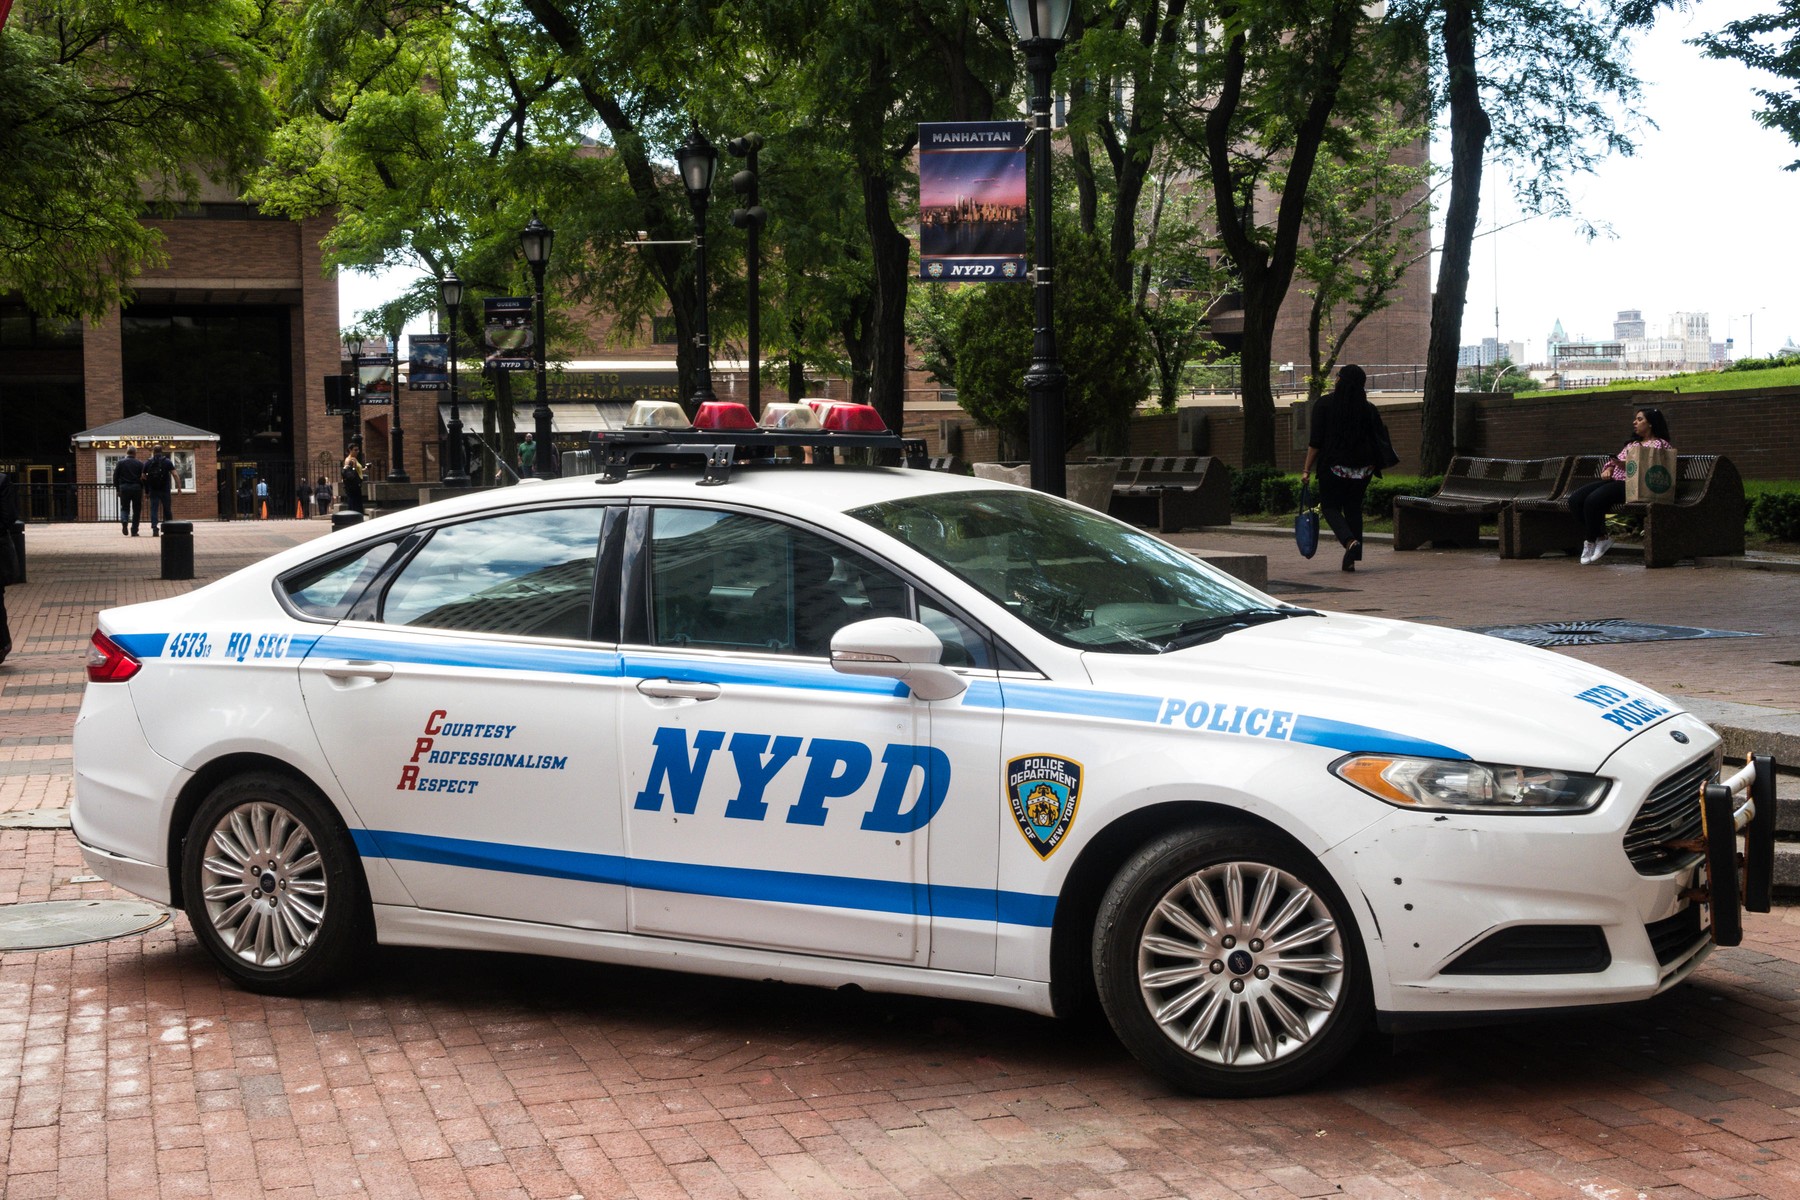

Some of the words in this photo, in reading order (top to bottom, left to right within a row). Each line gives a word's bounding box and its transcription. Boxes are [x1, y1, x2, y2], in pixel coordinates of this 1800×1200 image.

[932, 131, 1011, 143] MANHATTAN
[950, 265, 995, 276] NYPD
[599, 373, 620, 385] TO
[91, 440, 116, 449] ONE
[119, 440, 159, 449] POLICE
[169, 632, 208, 658] 4573
[224, 632, 252, 662] HQ
[254, 632, 290, 659] SEC
[1574, 685, 1629, 709] NYPD
[424, 709, 516, 738] COURTESY
[1160, 698, 1293, 740] POLICE
[410, 737, 568, 769] PROFESSIONALISM
[1024, 758, 1065, 772] POLICE
[396, 765, 479, 794] RESPECT
[633, 727, 951, 834] NYPD
[1010, 769, 1077, 789] DEPARTMENT
[1012, 798, 1026, 823] CITY
[1024, 826, 1036, 840] OF
[1048, 824, 1065, 846] NEW
[1062, 795, 1076, 823] YORK
